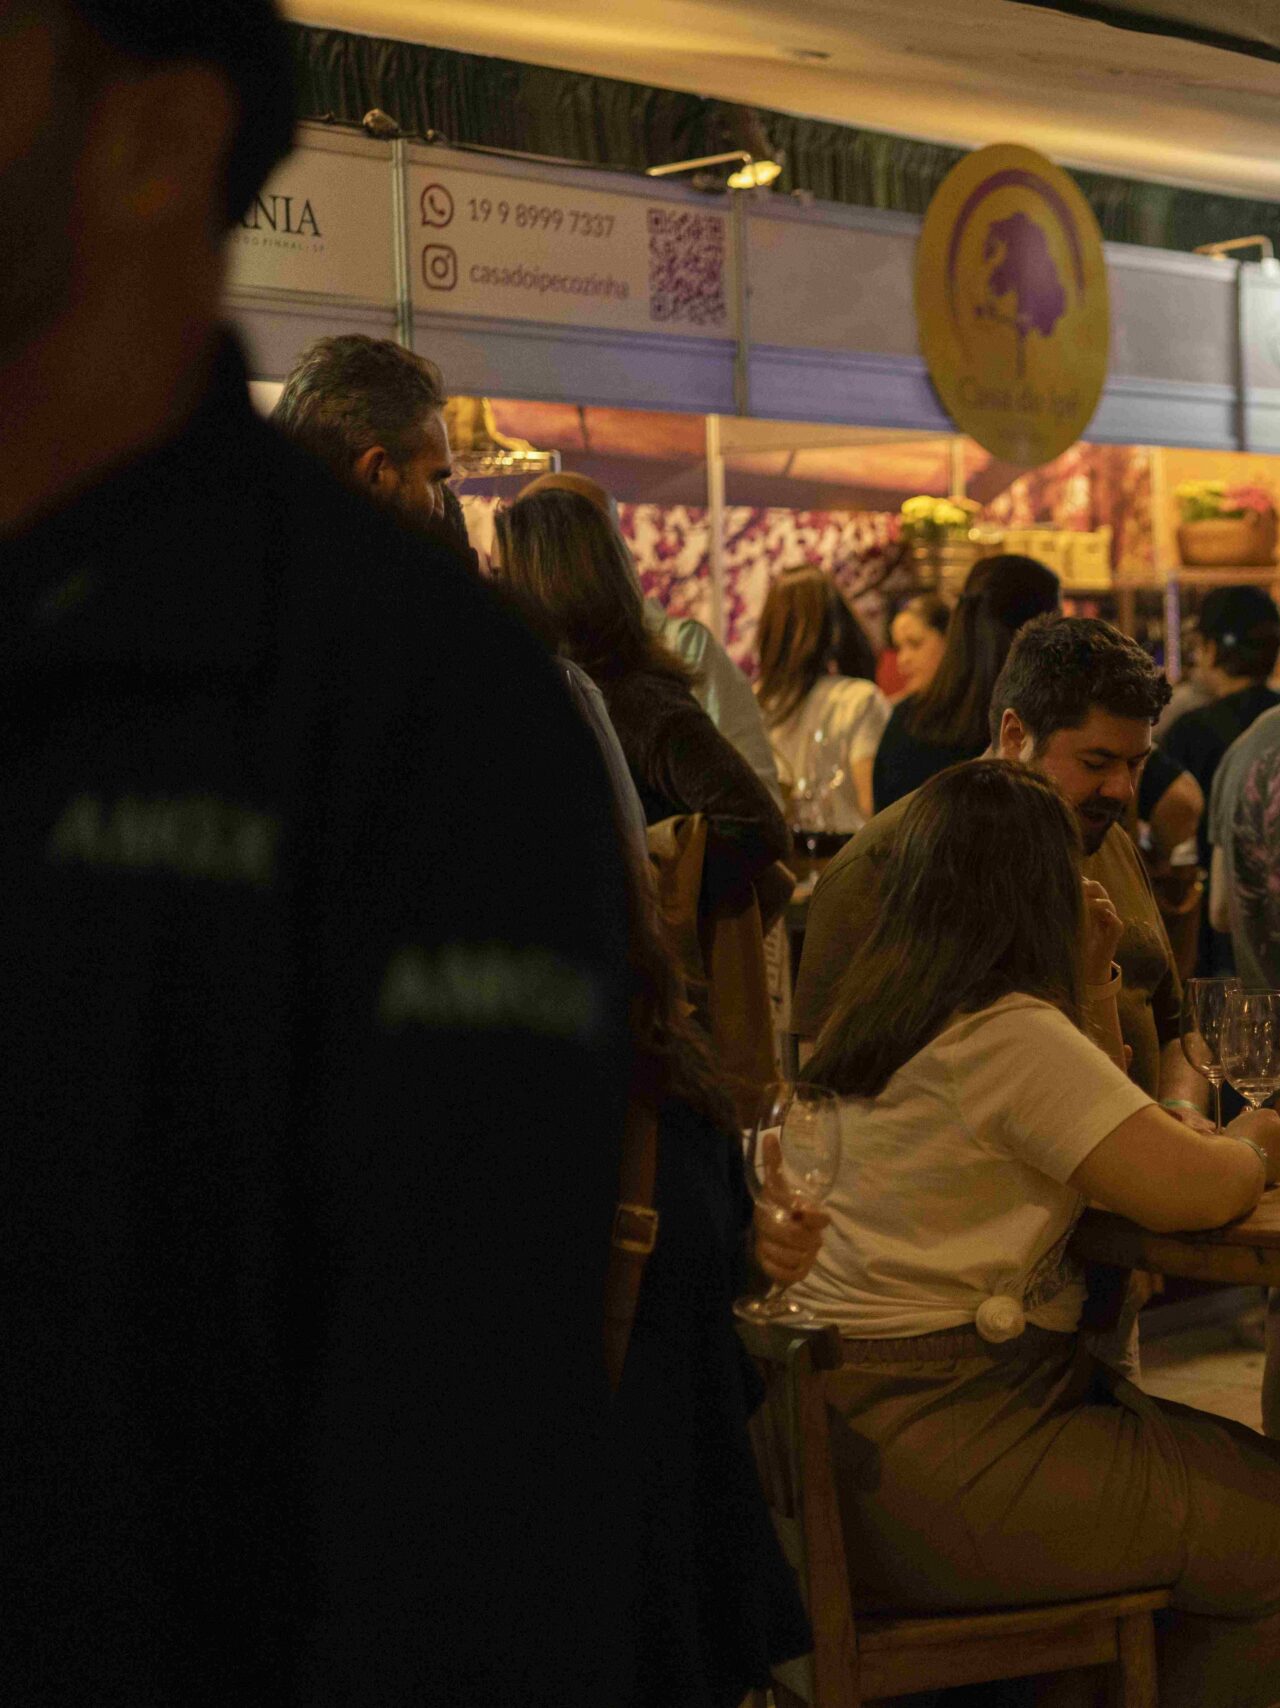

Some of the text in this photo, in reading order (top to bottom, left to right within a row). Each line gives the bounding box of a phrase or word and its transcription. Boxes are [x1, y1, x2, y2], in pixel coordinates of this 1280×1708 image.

[240, 191, 322, 237] NIA
[469, 197, 615, 238] 19 9 8999 7337
[469, 263, 629, 300] casadoipecozinha
